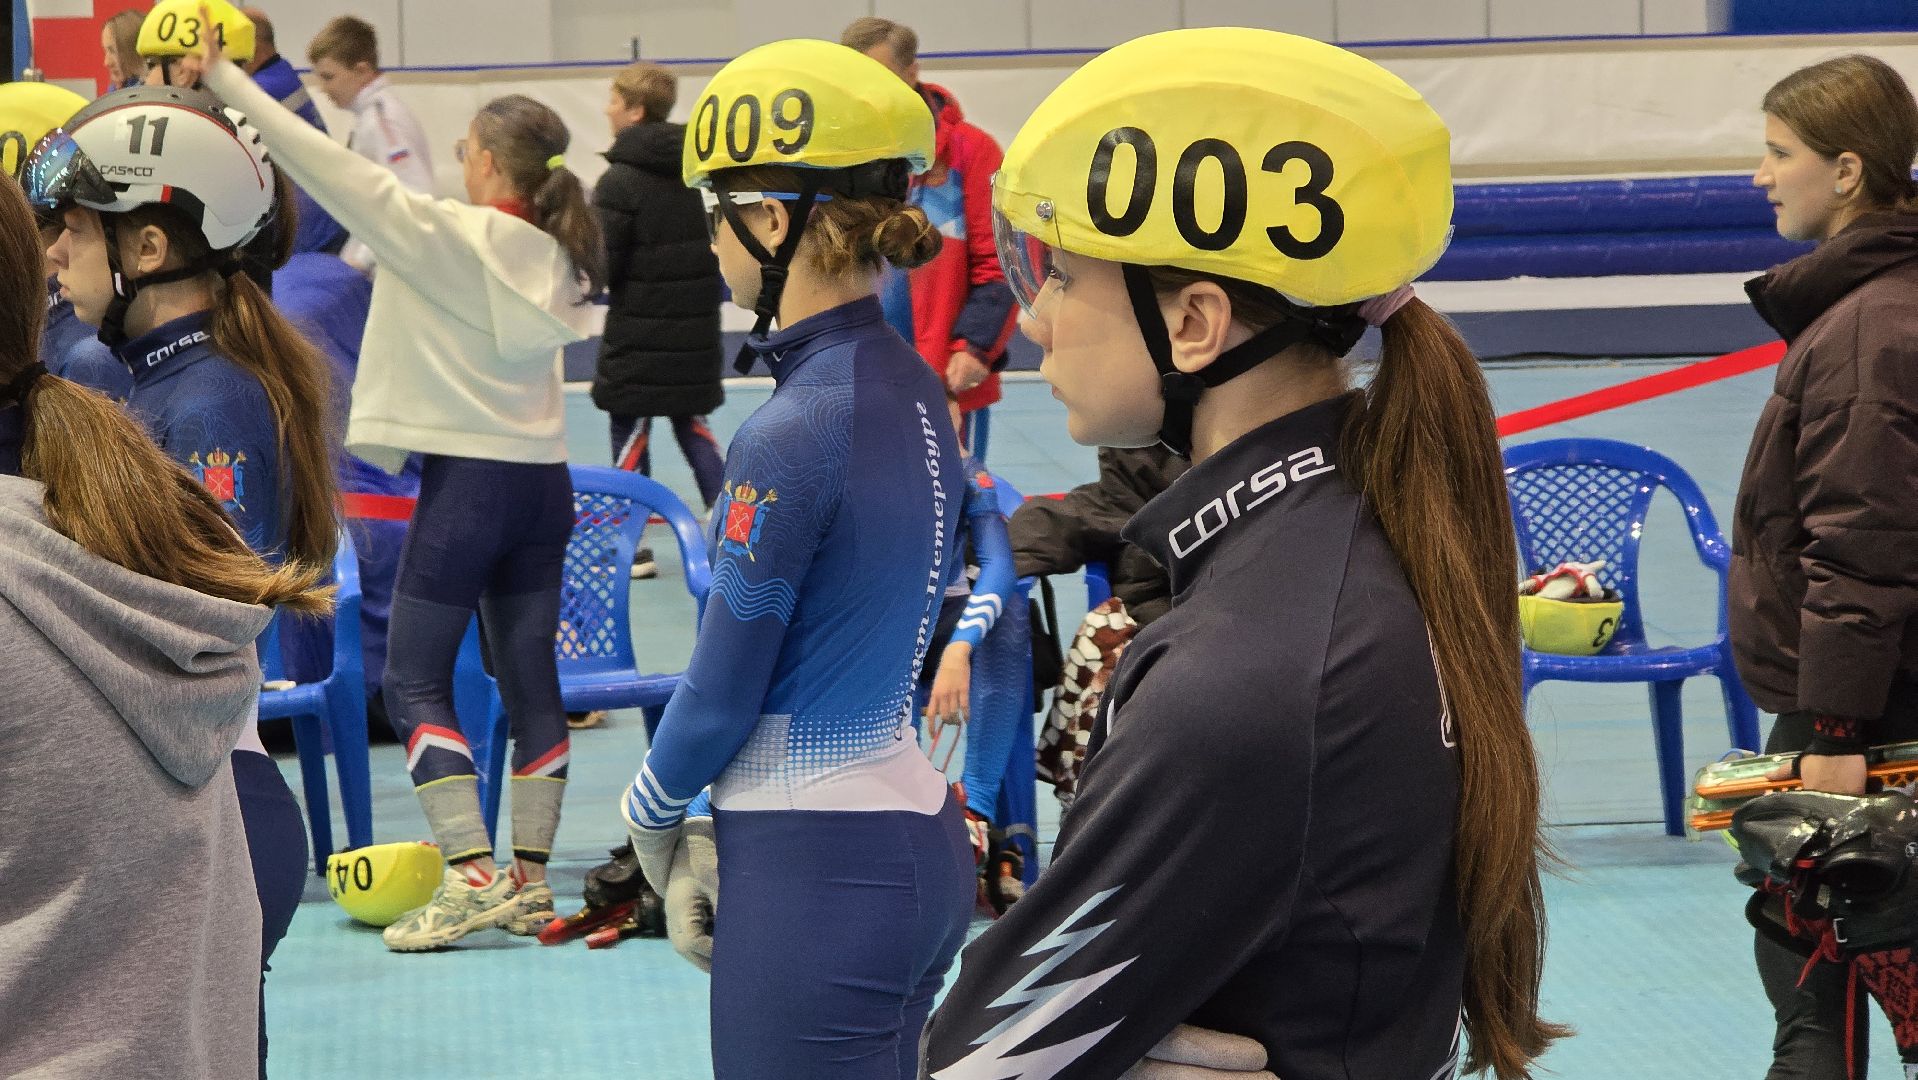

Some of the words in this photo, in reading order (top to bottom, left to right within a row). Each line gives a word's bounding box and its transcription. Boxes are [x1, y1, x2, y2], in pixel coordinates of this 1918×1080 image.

[127, 115, 169, 156] 11
[695, 88, 815, 163] 009
[1086, 126, 1345, 260] 003
[147, 331, 210, 366] corsa
[1168, 446, 1336, 559] corsa
[327, 856, 372, 898] 04
